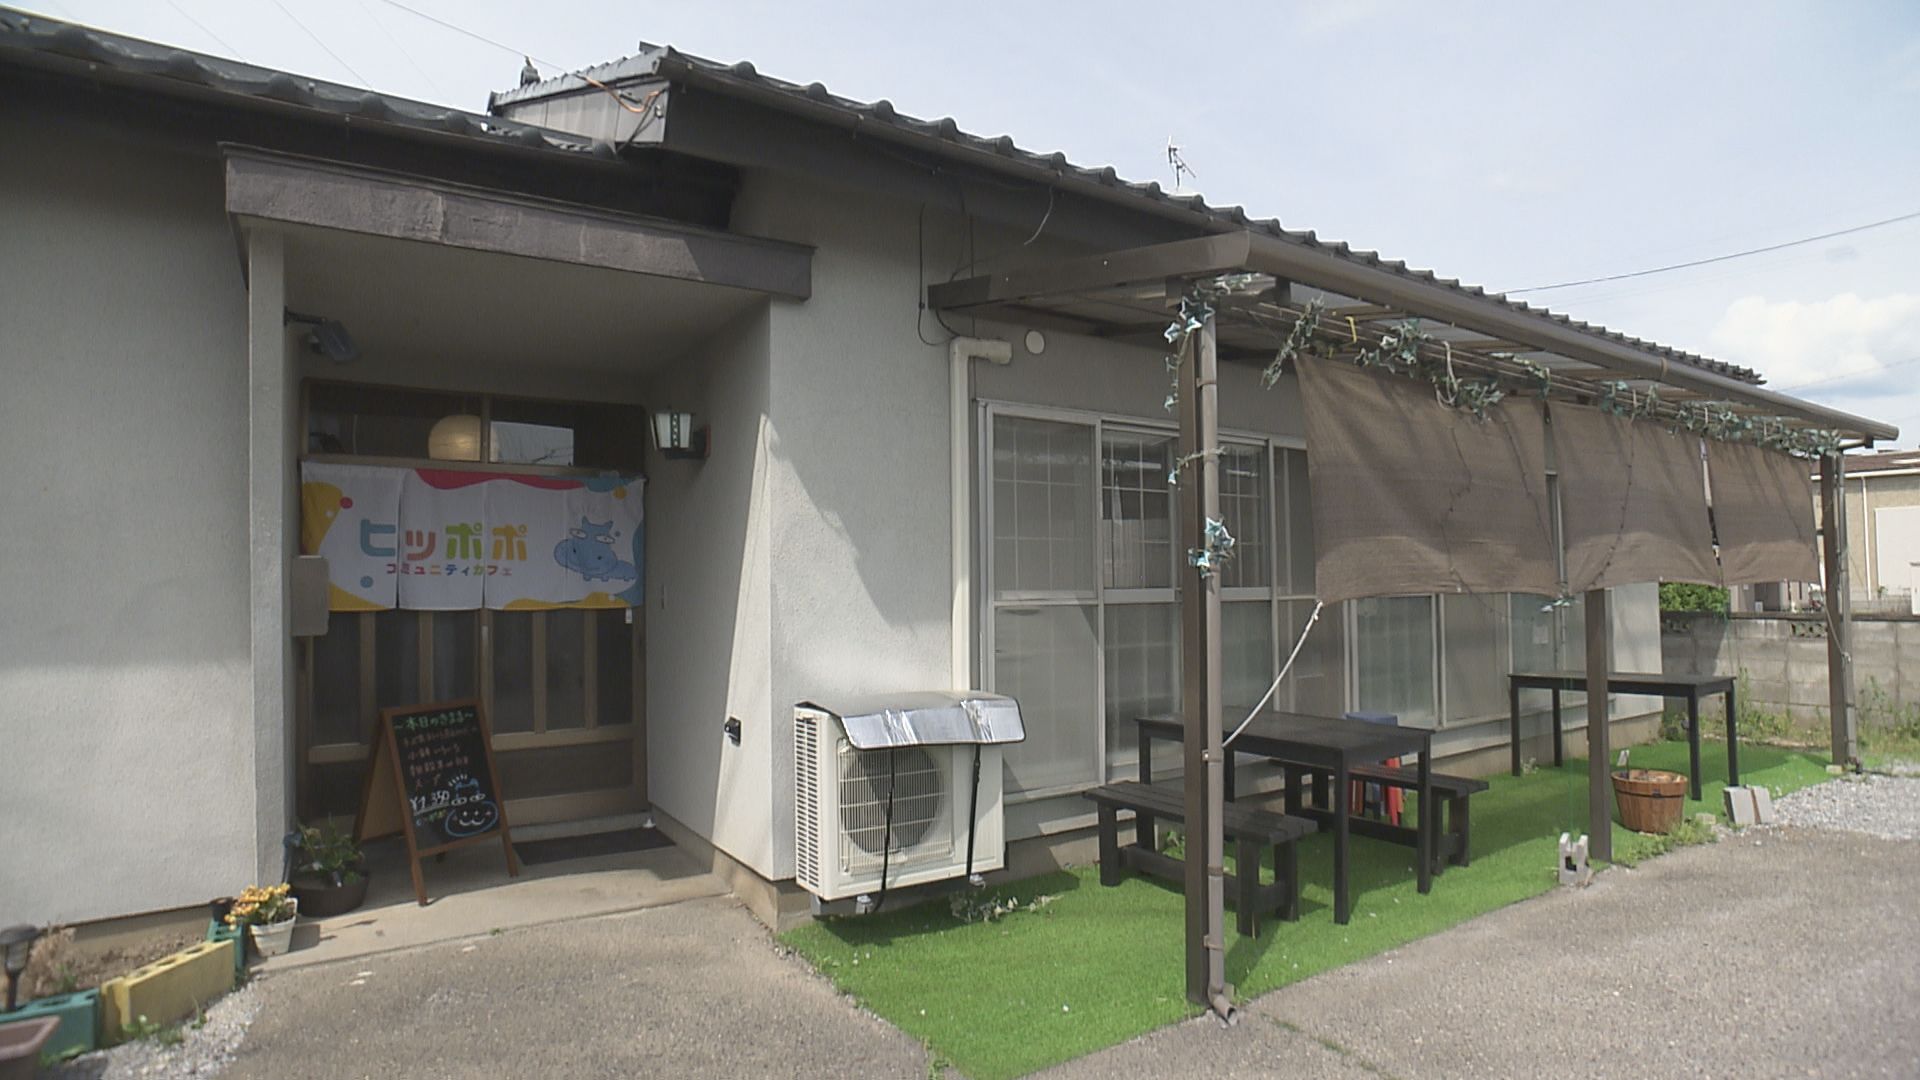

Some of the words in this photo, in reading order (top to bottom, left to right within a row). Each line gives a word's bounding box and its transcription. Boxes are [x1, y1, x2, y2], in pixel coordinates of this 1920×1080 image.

[360, 519, 528, 561] ヒッポポ
[386, 563, 512, 576] コミュニティカフェ
